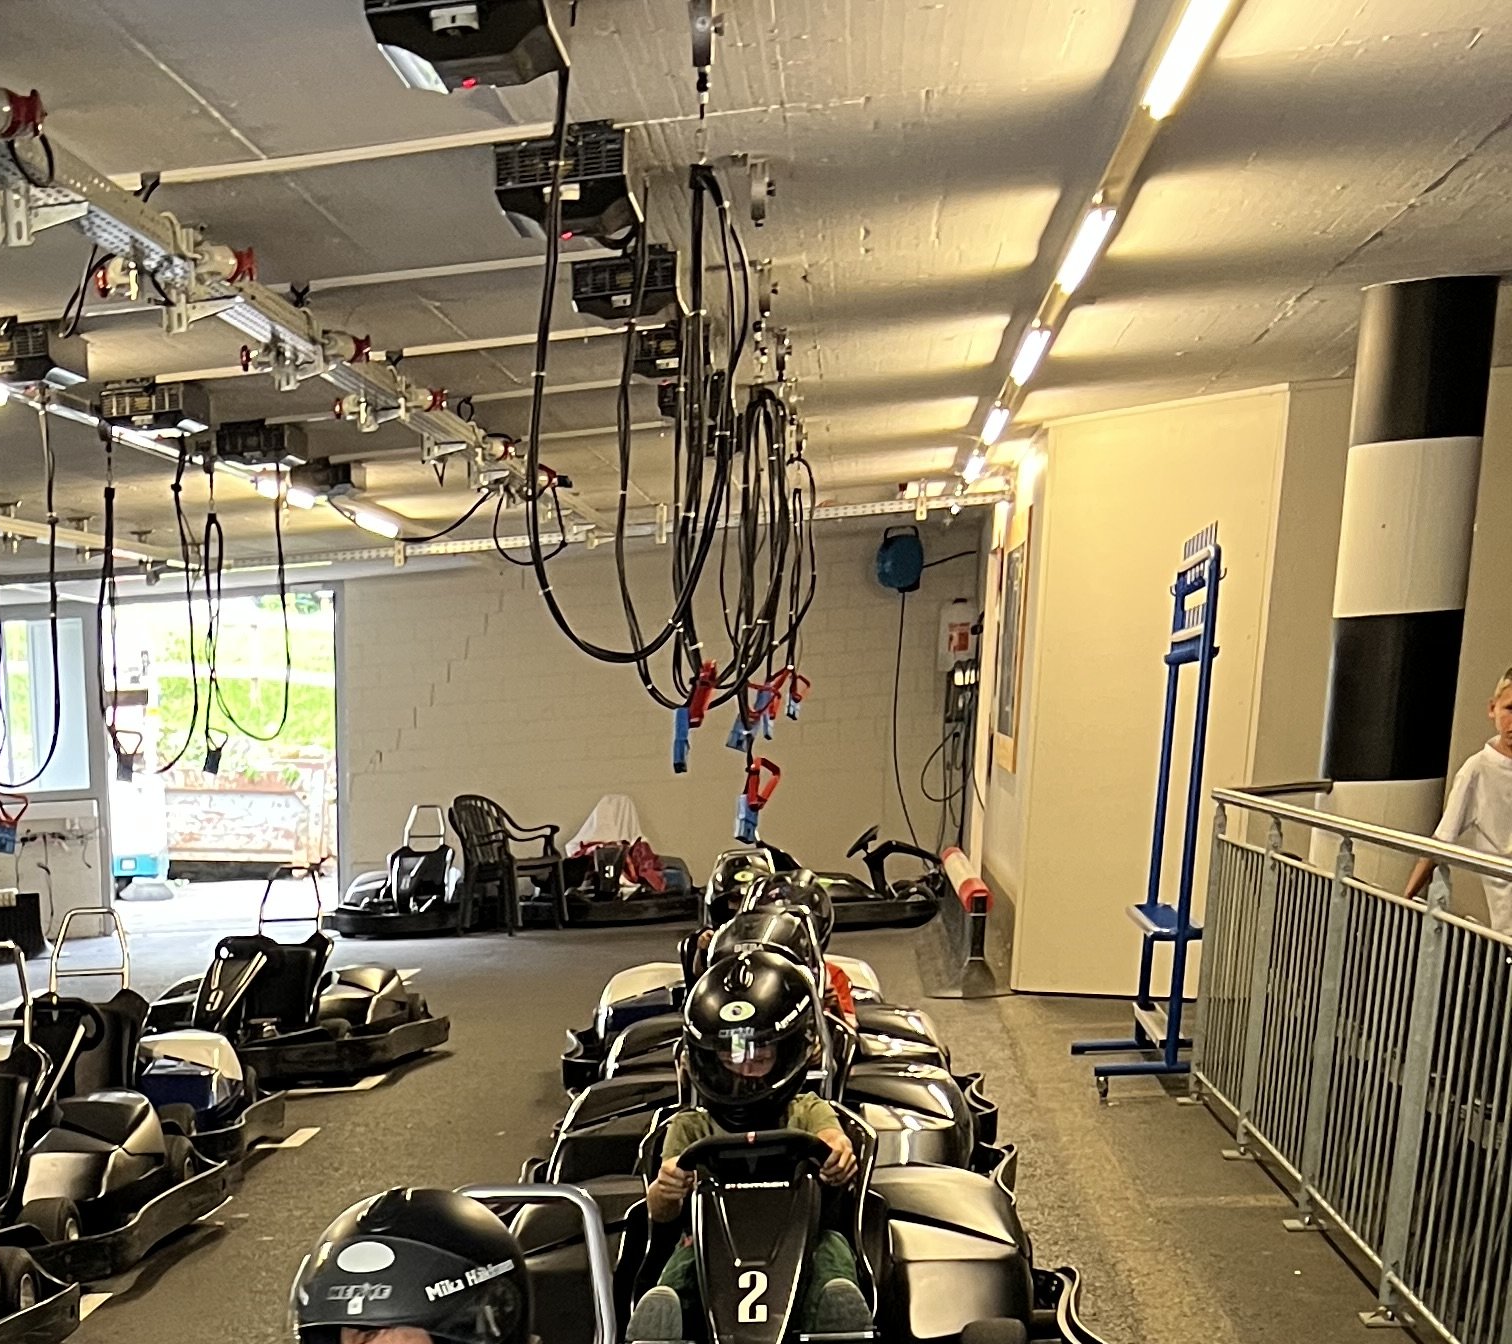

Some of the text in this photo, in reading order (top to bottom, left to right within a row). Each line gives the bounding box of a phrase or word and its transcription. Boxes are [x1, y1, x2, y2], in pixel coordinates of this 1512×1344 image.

[604, 865, 614, 878] 3
[205, 989, 225, 1012] 9
[424, 1278, 465, 1302] Mika
[737, 1270, 768, 1323] 2
